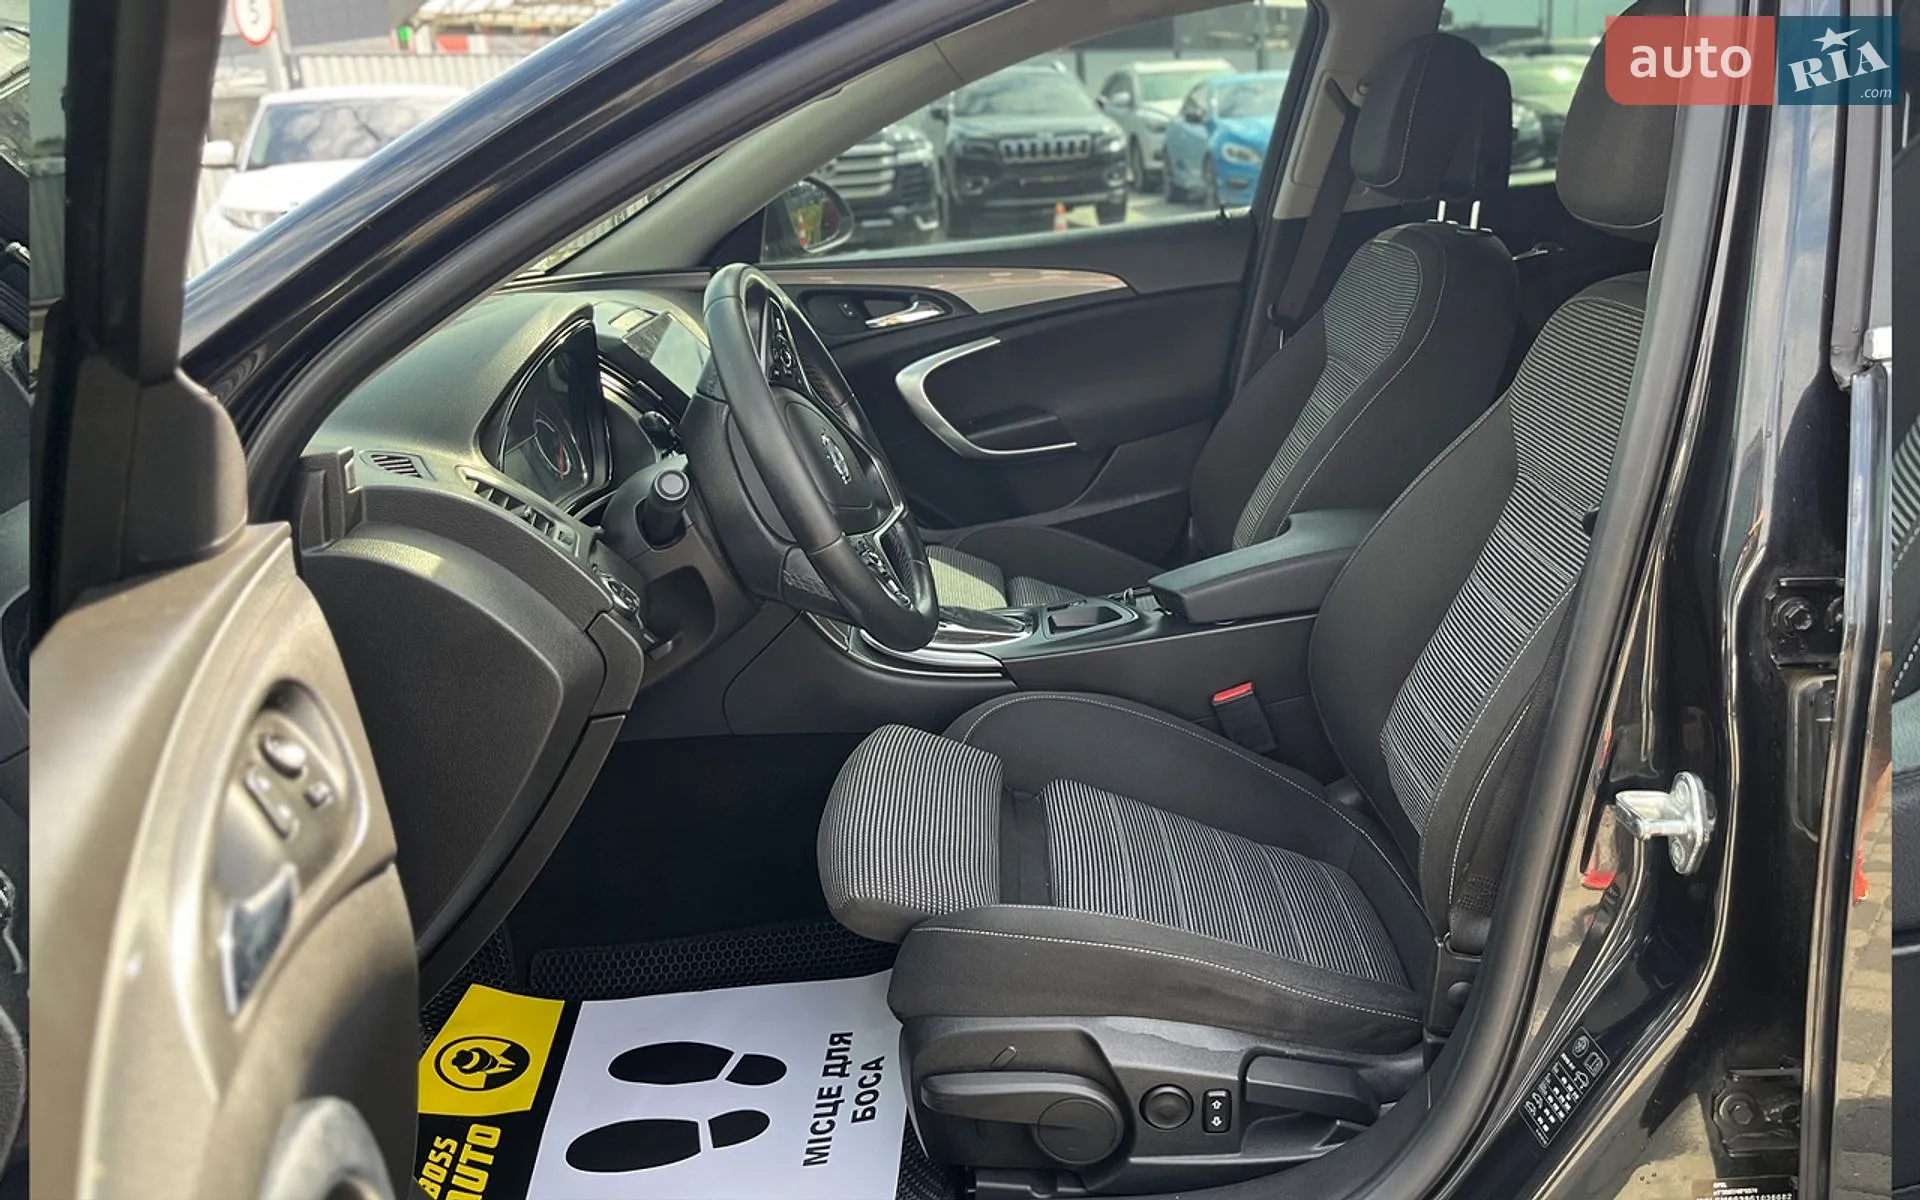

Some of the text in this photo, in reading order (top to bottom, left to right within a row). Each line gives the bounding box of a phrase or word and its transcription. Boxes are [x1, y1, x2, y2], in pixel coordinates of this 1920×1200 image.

[803, 1031, 853, 1167] МІСЦЕ ДЛЯ
[851, 1055, 885, 1124] БОСА
[418, 1135, 458, 1200] BOSS
